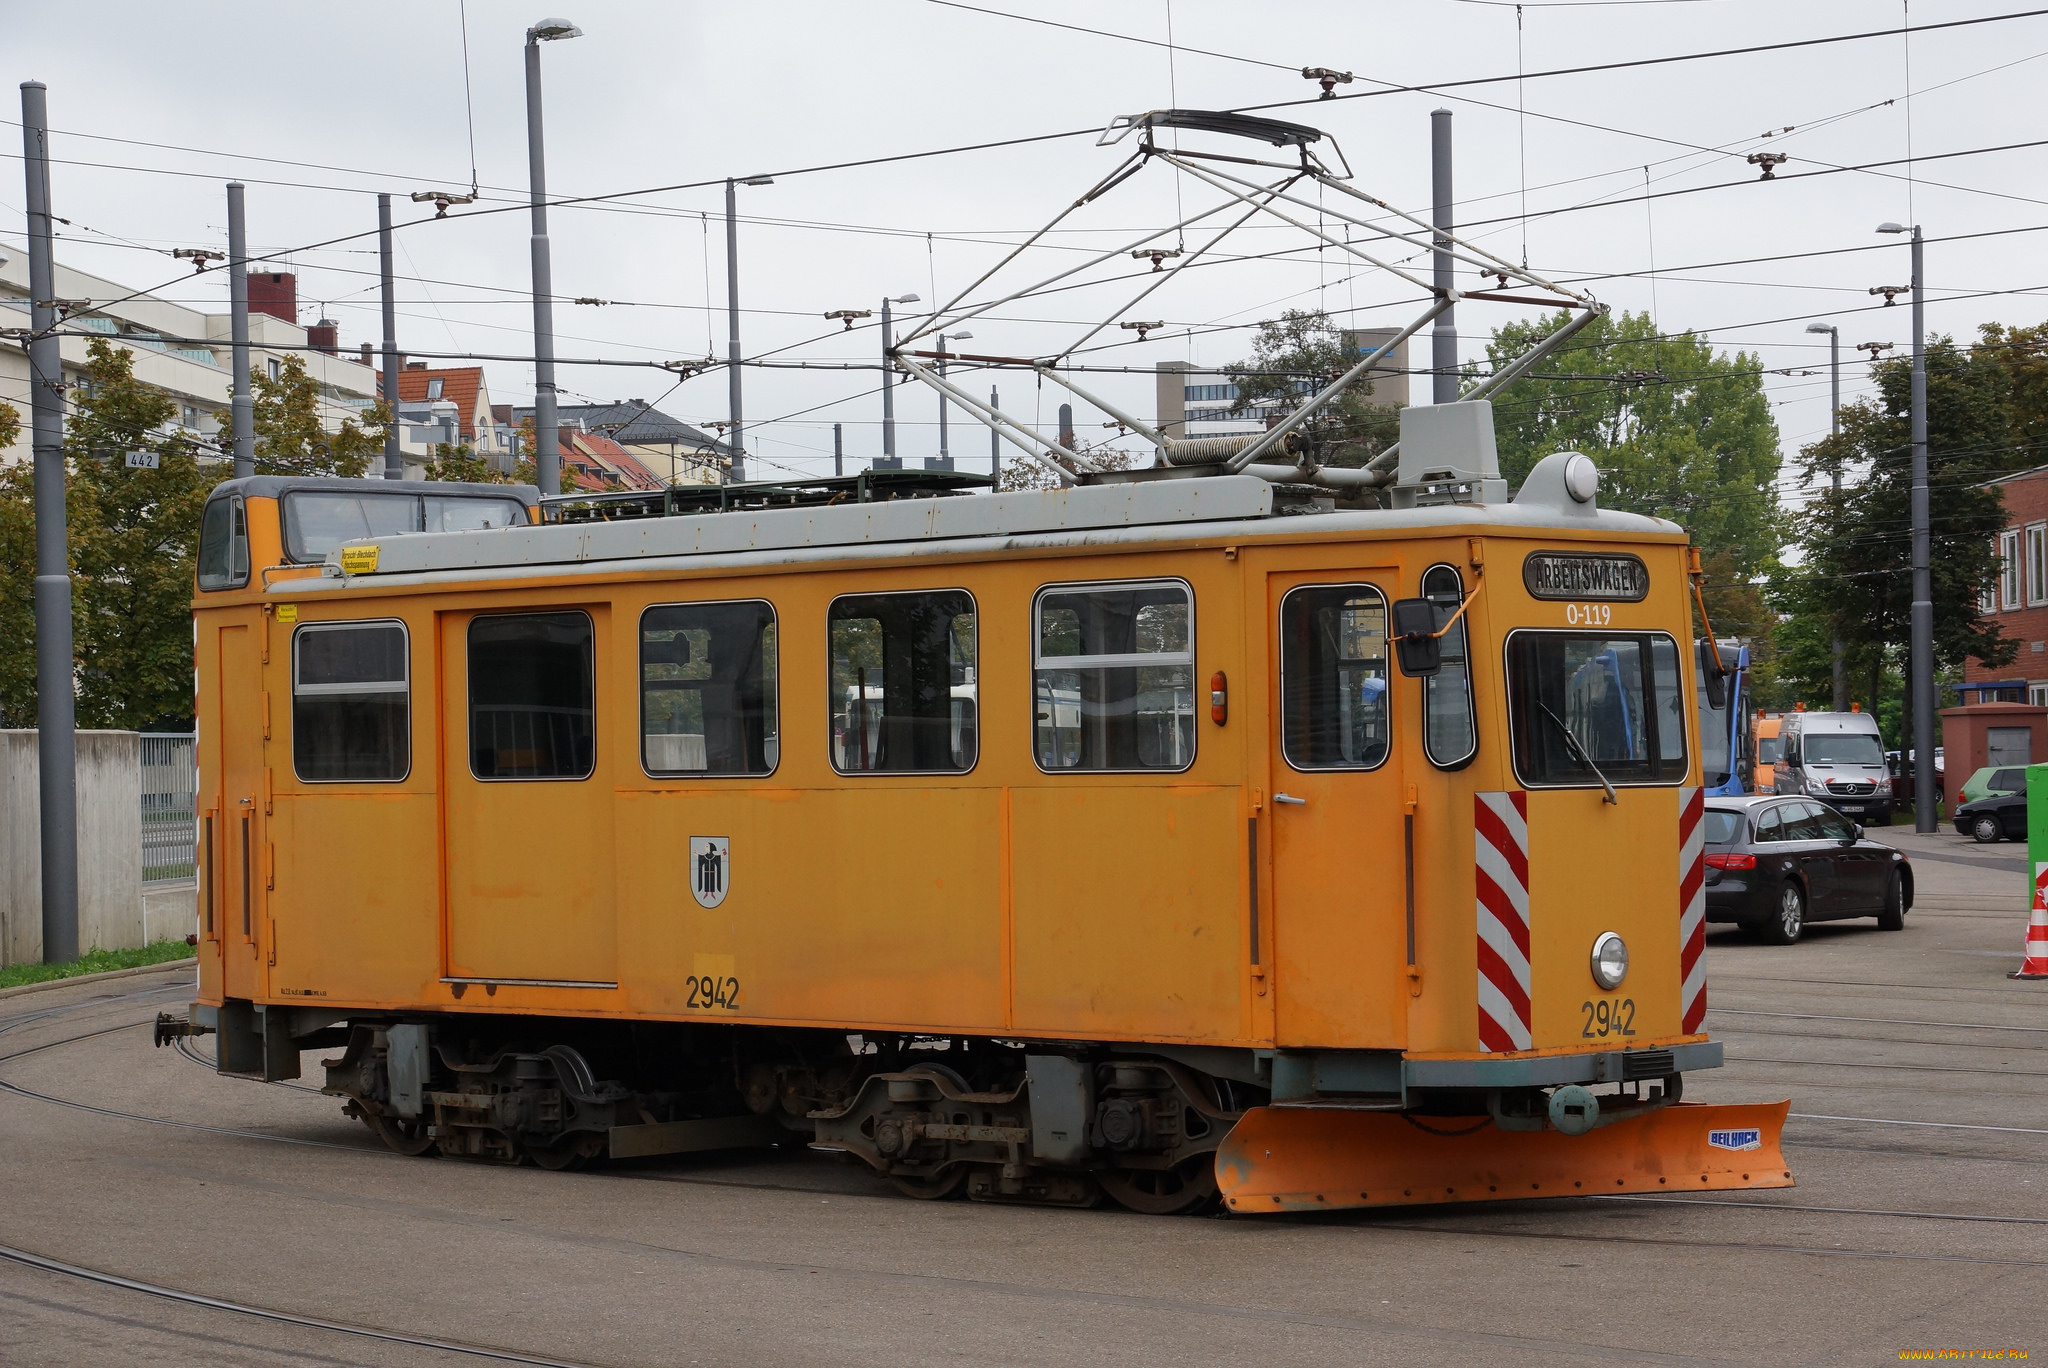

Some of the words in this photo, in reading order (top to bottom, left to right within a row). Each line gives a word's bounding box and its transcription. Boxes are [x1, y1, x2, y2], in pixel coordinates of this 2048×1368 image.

[131, 454, 153, 467] 442
[1535, 562, 1638, 591] ARBEITSWAGEN
[685, 975, 740, 1010] 2942
[1581, 998, 1636, 1038] 2942
[1711, 1131, 1758, 1148] BEILHACK
